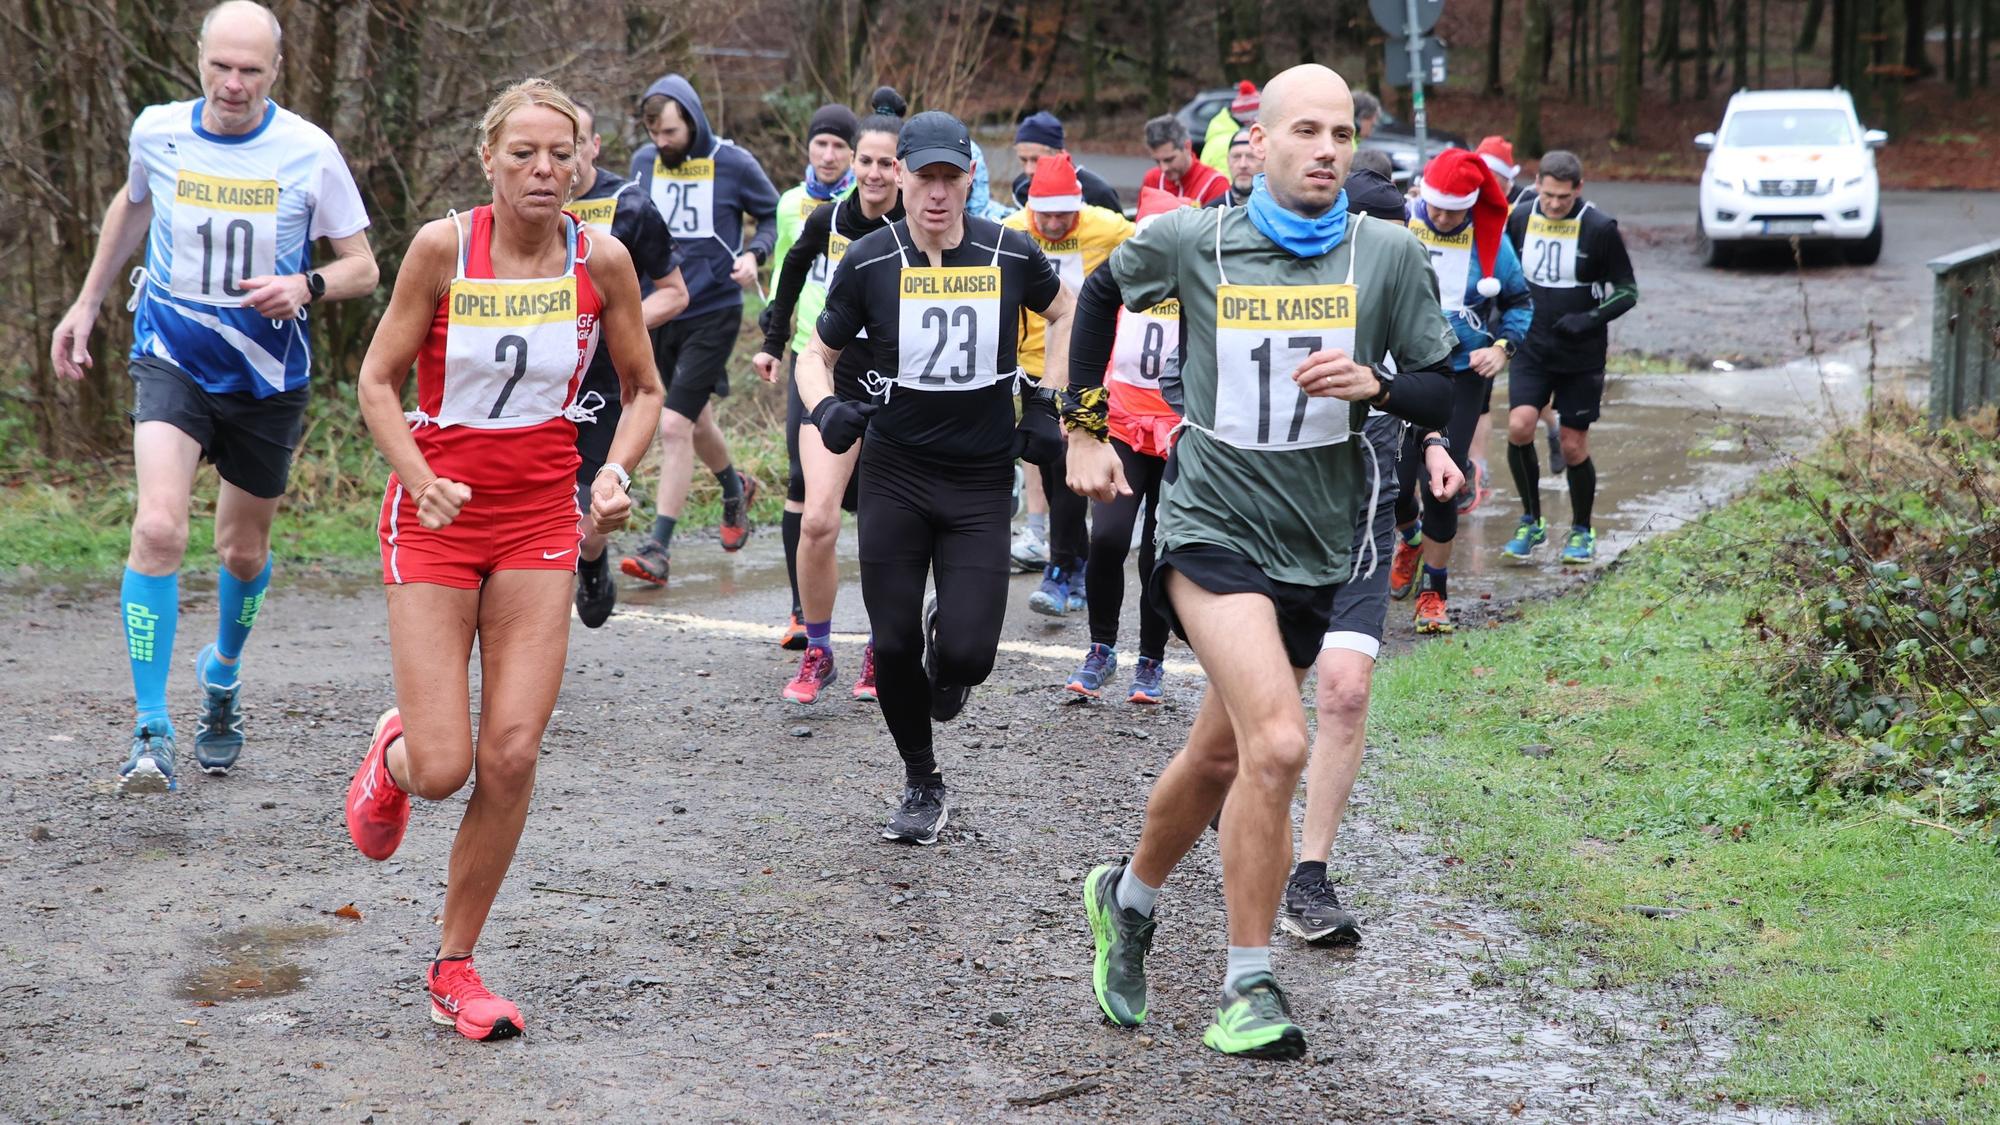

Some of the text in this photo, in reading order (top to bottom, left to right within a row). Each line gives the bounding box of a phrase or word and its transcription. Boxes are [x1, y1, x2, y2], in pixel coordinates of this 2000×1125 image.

[177, 179, 275, 206] OPEL KAISER
[667, 182, 699, 233] 25
[196, 217, 254, 297] 10
[1410, 226, 1469, 245] OPEL KAISER
[1532, 239, 1562, 283] 20
[454, 289, 571, 318] OPEL KAISER
[903, 274, 997, 294] OPEL KAISER
[1151, 303, 1179, 316] KAIS
[1222, 295, 1350, 321] OPEL KAISER
[918, 305, 978, 385] 23
[1140, 321, 1164, 381] 8
[487, 334, 529, 420] 2
[1250, 336, 1323, 444] 17
